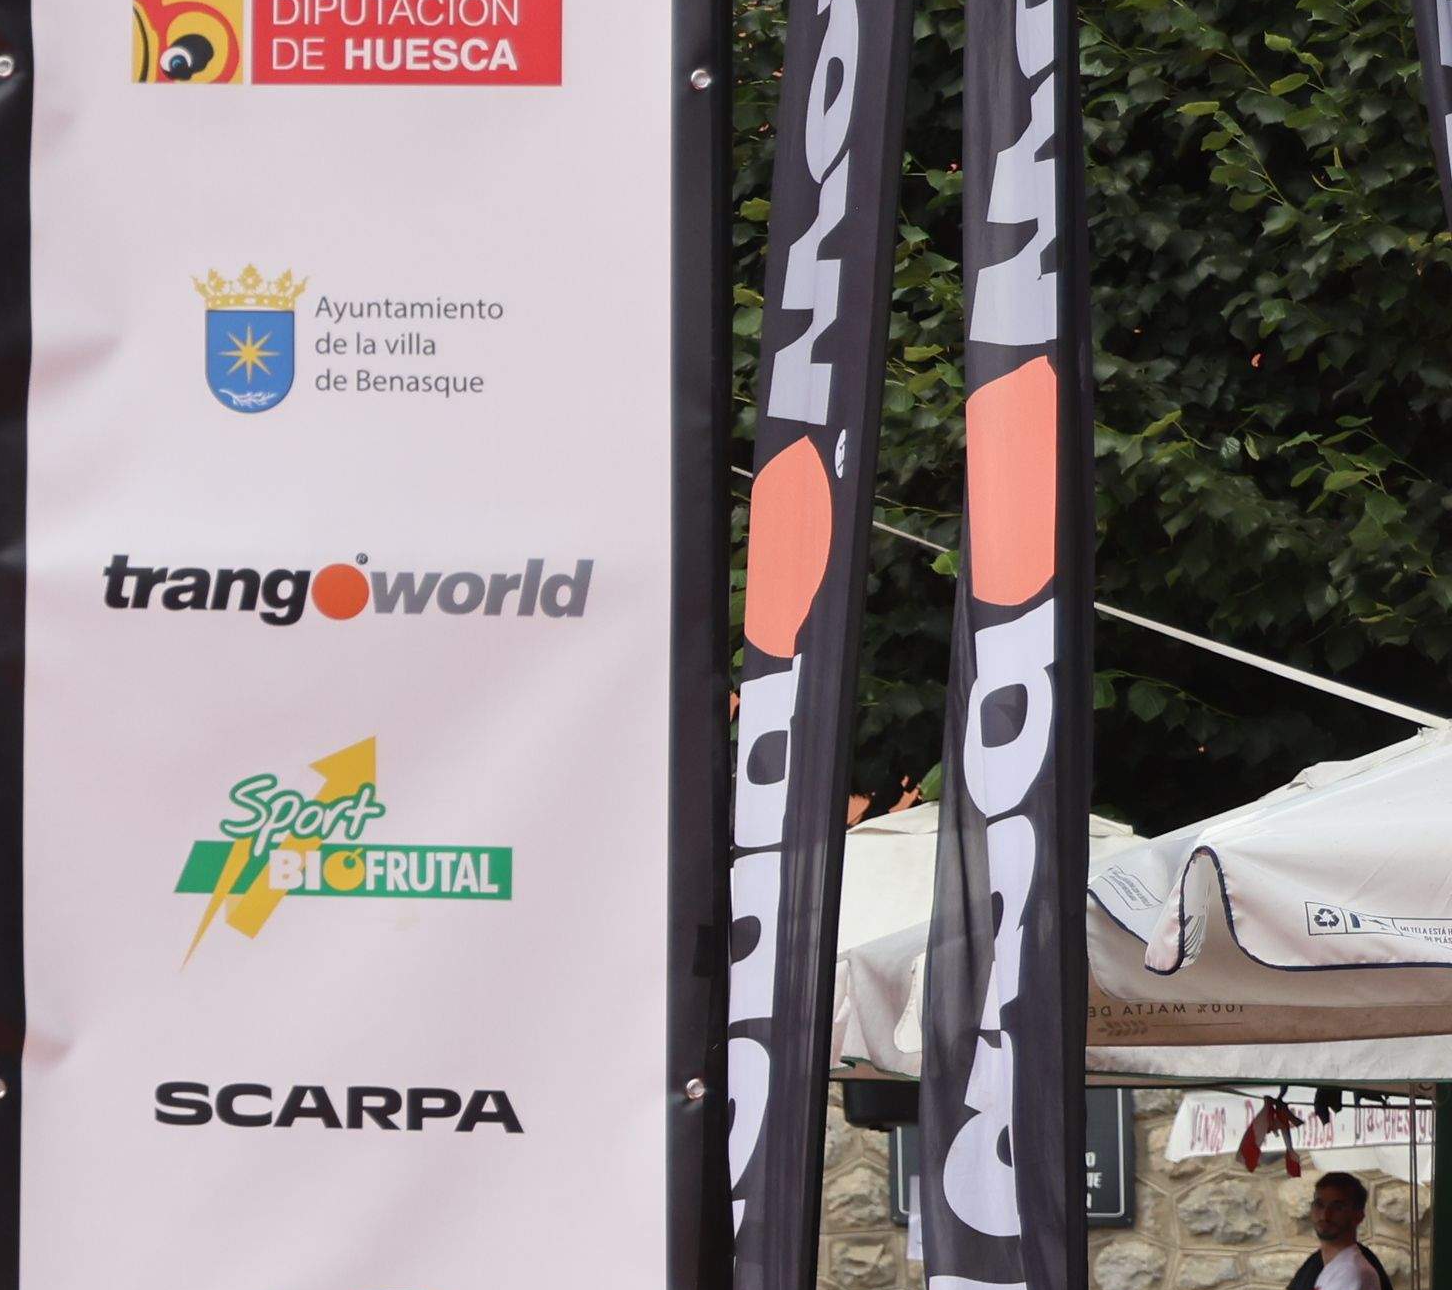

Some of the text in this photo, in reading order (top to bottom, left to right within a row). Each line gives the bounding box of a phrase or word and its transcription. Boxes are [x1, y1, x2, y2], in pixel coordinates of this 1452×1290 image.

[272, 38, 518, 71] DE HUESCA
[315, 296, 504, 323] Ayuntamiento
[315, 332, 436, 356] de la villa
[315, 369, 484, 397] de Benasque
[219, 774, 384, 856] Sport
[268, 847, 499, 893] BIOFRUTAL
[154, 1081, 525, 1134] SCARPA
